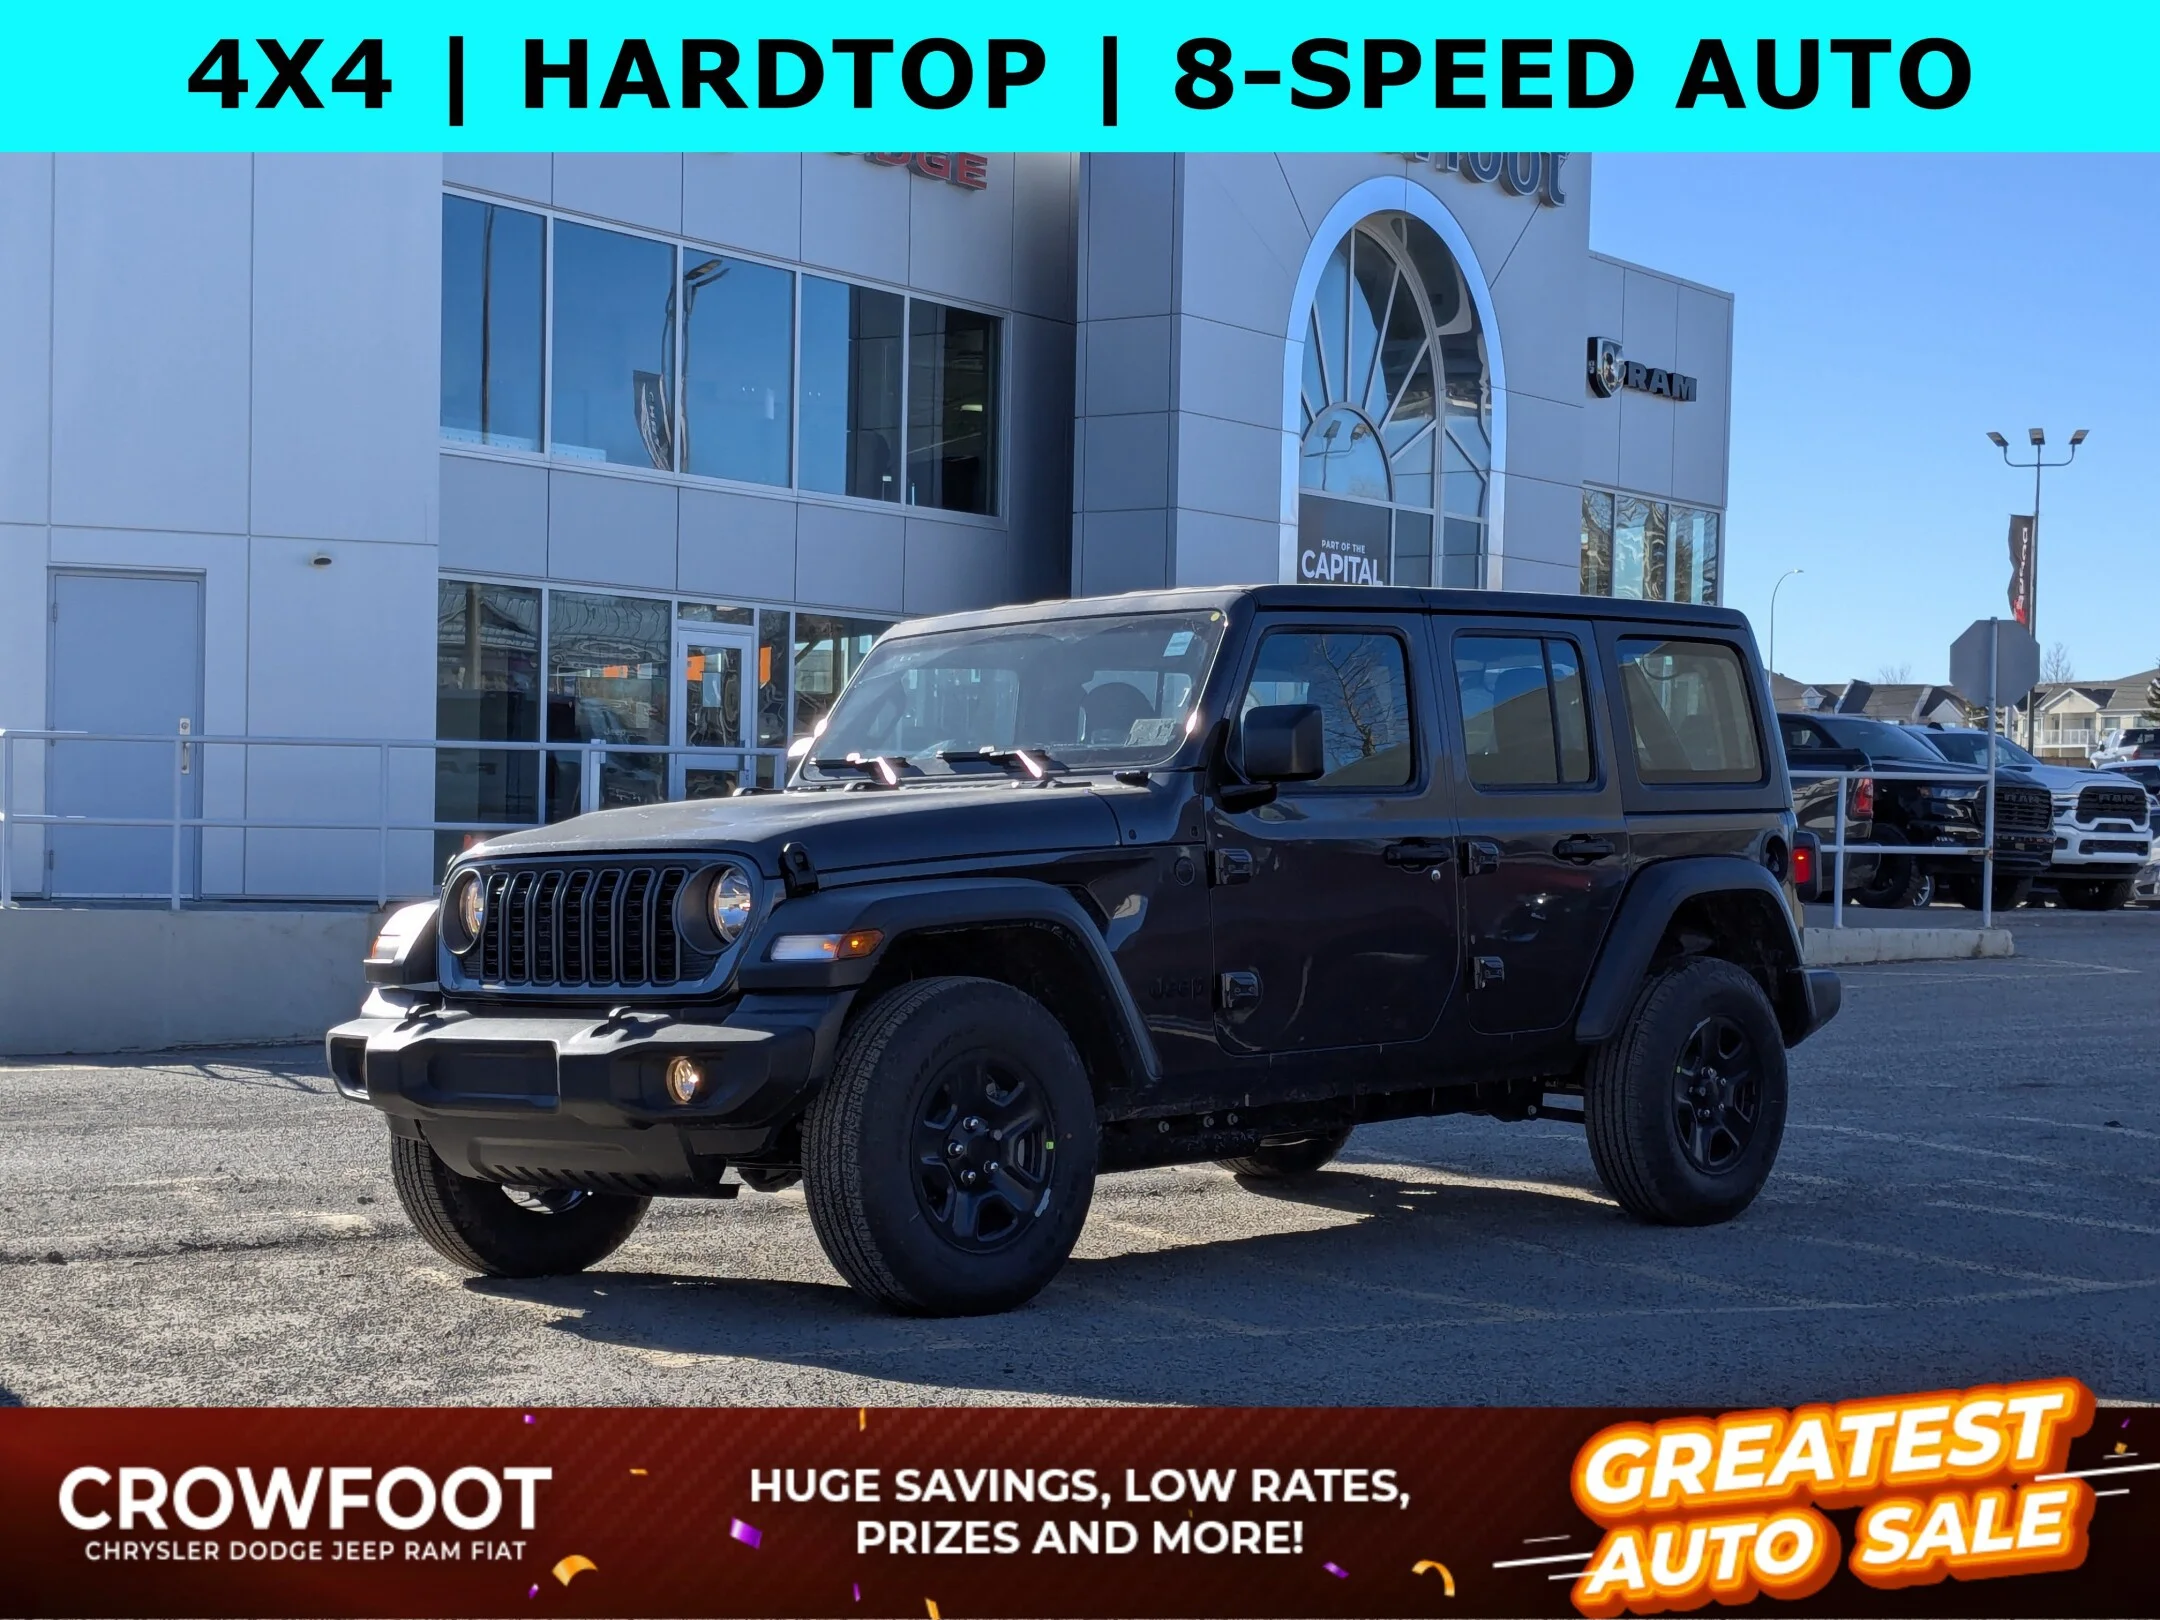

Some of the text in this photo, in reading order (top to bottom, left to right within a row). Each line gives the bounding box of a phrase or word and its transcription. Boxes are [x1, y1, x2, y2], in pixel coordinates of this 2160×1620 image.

[1625, 361, 1697, 402] RAM
[1321, 539, 1366, 554] PART OF THE
[1301, 549, 1384, 586] CAPITAL
